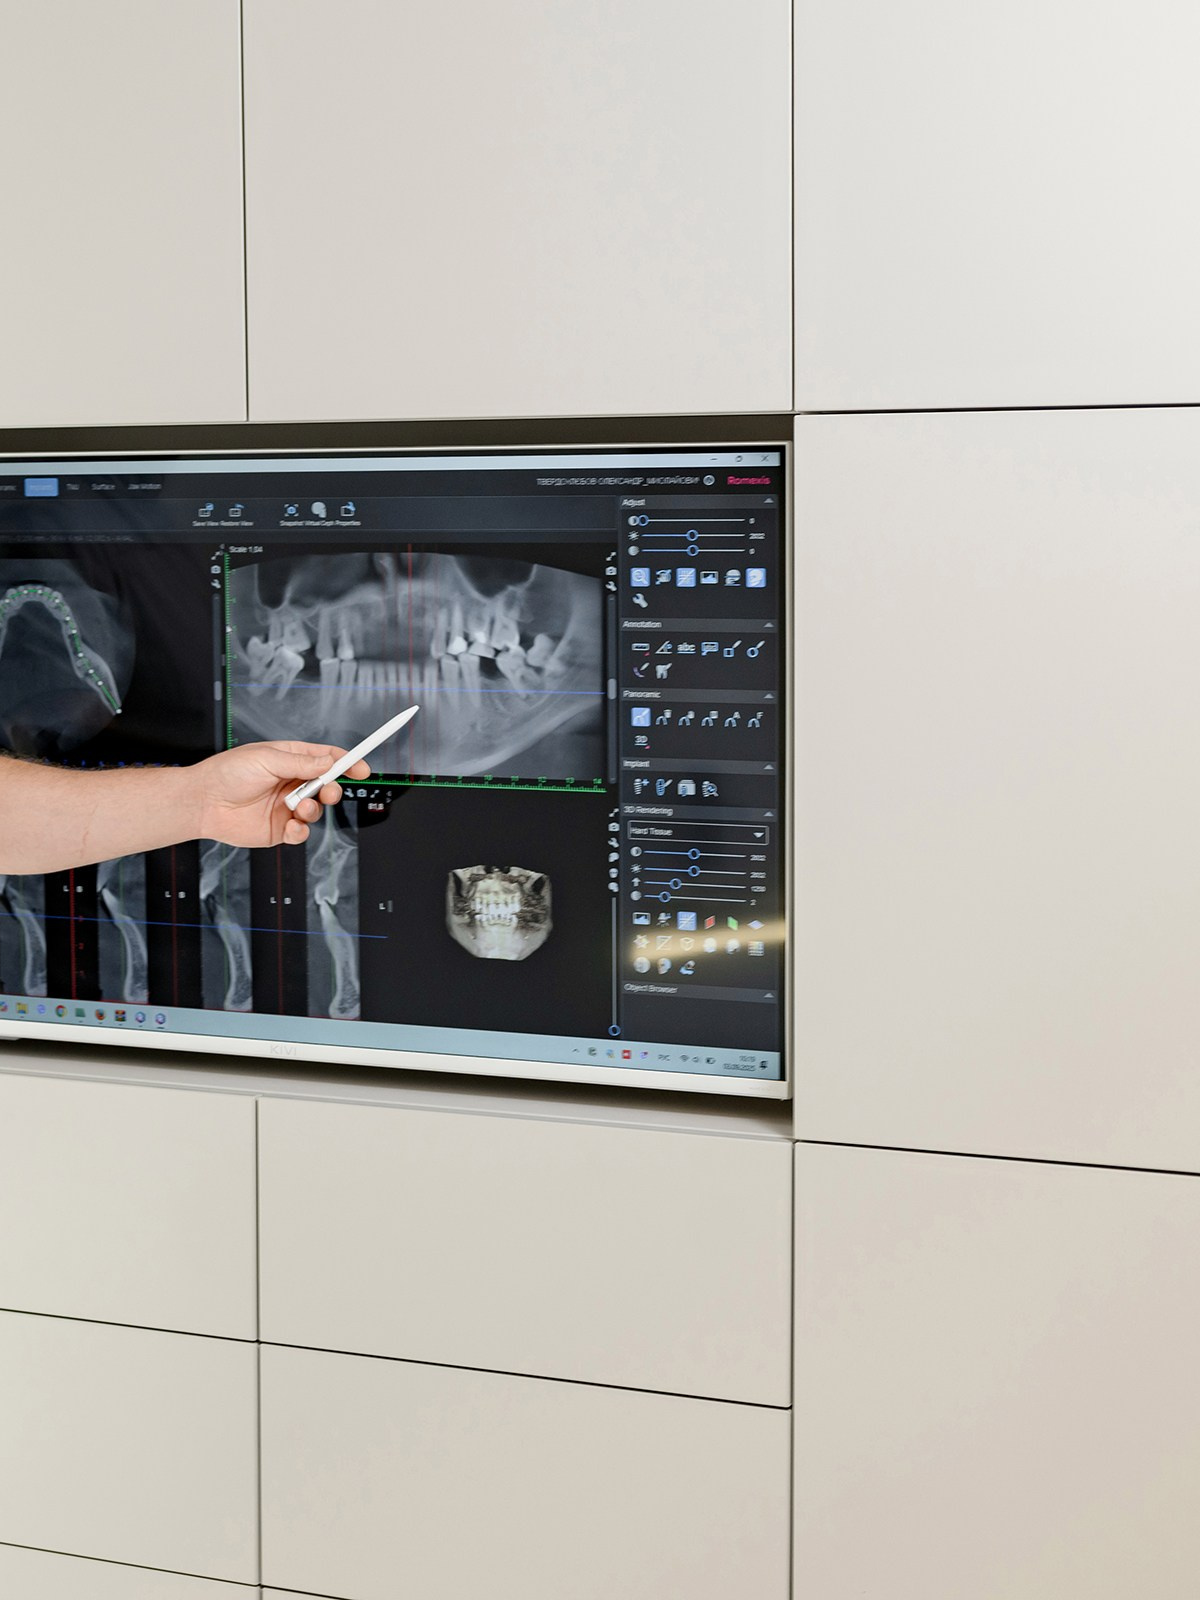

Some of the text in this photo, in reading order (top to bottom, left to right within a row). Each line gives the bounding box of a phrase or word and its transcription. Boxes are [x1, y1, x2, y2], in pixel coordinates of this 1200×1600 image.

[727, 476, 771, 485] Romexis
[91, 483, 116, 491] Surface
[622, 498, 646, 508] Adjust
[622, 620, 662, 629] Annotation
[623, 690, 662, 699] Panoramic
[623, 760, 650, 768] Implant
[624, 806, 674, 816] 3D Rendering
[630, 827, 673, 837] Hard Tissue
[624, 983, 678, 994] Object Browser
